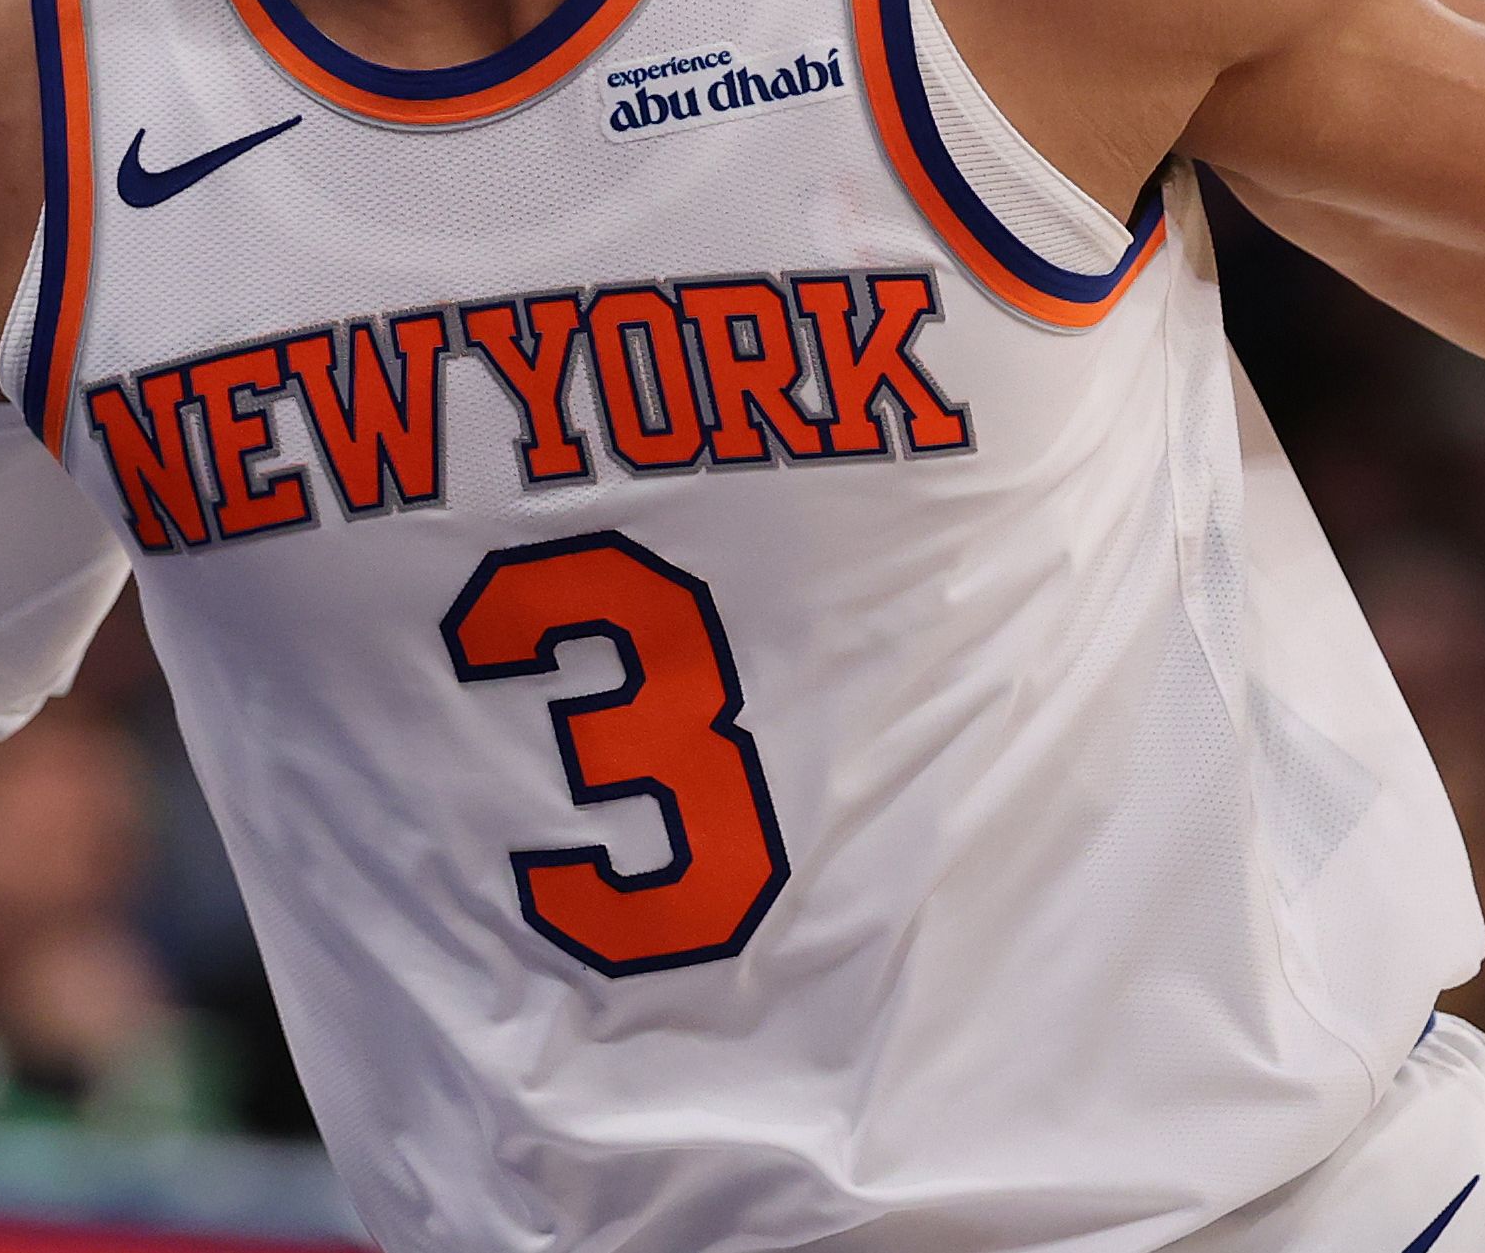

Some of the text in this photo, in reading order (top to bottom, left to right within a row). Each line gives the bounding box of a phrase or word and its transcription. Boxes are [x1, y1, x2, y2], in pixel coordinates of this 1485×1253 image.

[610, 86, 702, 132] abu
[78, 264, 978, 556] NEW YORK
[439, 529, 792, 979] 3
